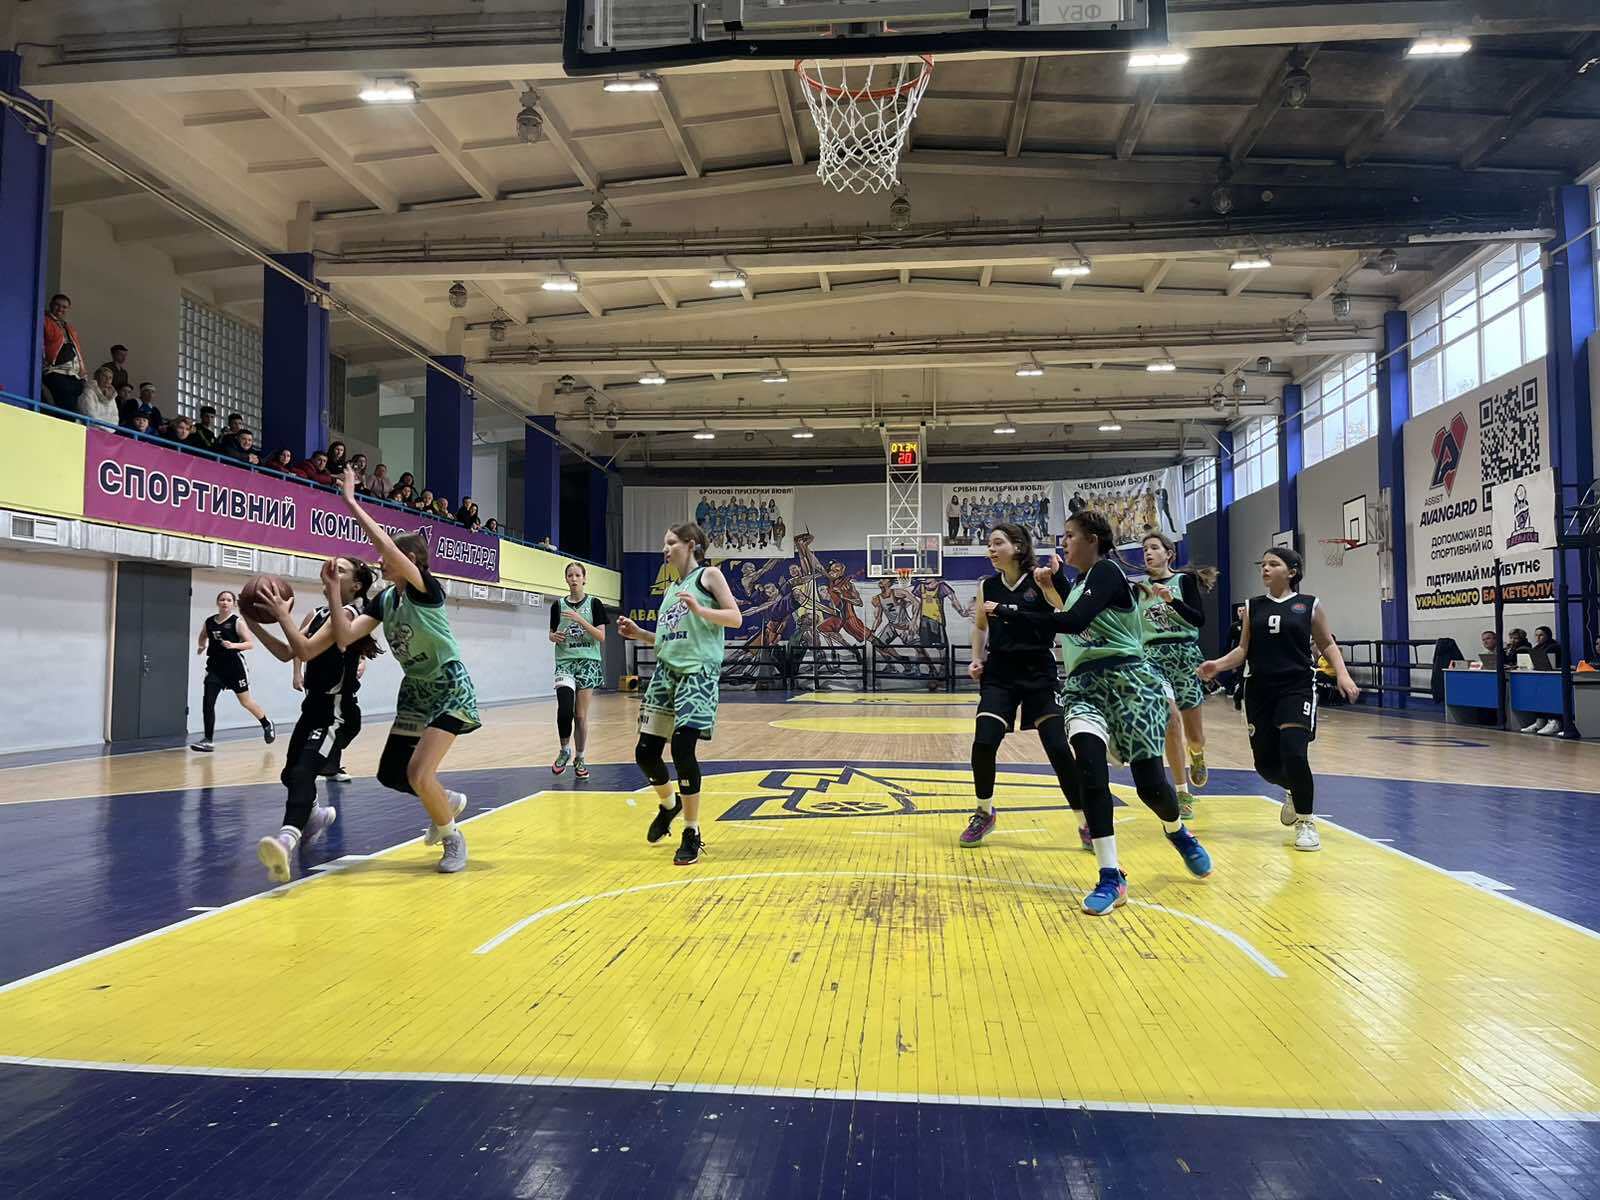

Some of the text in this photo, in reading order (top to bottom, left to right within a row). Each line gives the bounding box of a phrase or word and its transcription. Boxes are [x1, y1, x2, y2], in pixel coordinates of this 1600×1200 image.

[898, 452, 912, 464] 20
[1077, 480, 1127, 491] ЧЕМПІОНИ
[1424, 494, 1444, 506] ASSIST
[98, 460, 296, 530] СПОРТИВНИЙ
[436, 537, 497, 572] АВАНГАРД
[1419, 498, 1478, 528] AVANGARD
[1431, 525, 1493, 548] ДОПОМОЖИ ВІД
[1431, 540, 1481, 560] СПОРТИВНИЙ
[1481, 539, 1493, 551] КО
[1426, 565, 1480, 588] ПІДТРИМАЙ
[1415, 589, 1479, 609] УКРАЇНСЬКОГО
[1268, 615, 1281, 634] 9
[1303, 701, 1311, 716] 9
